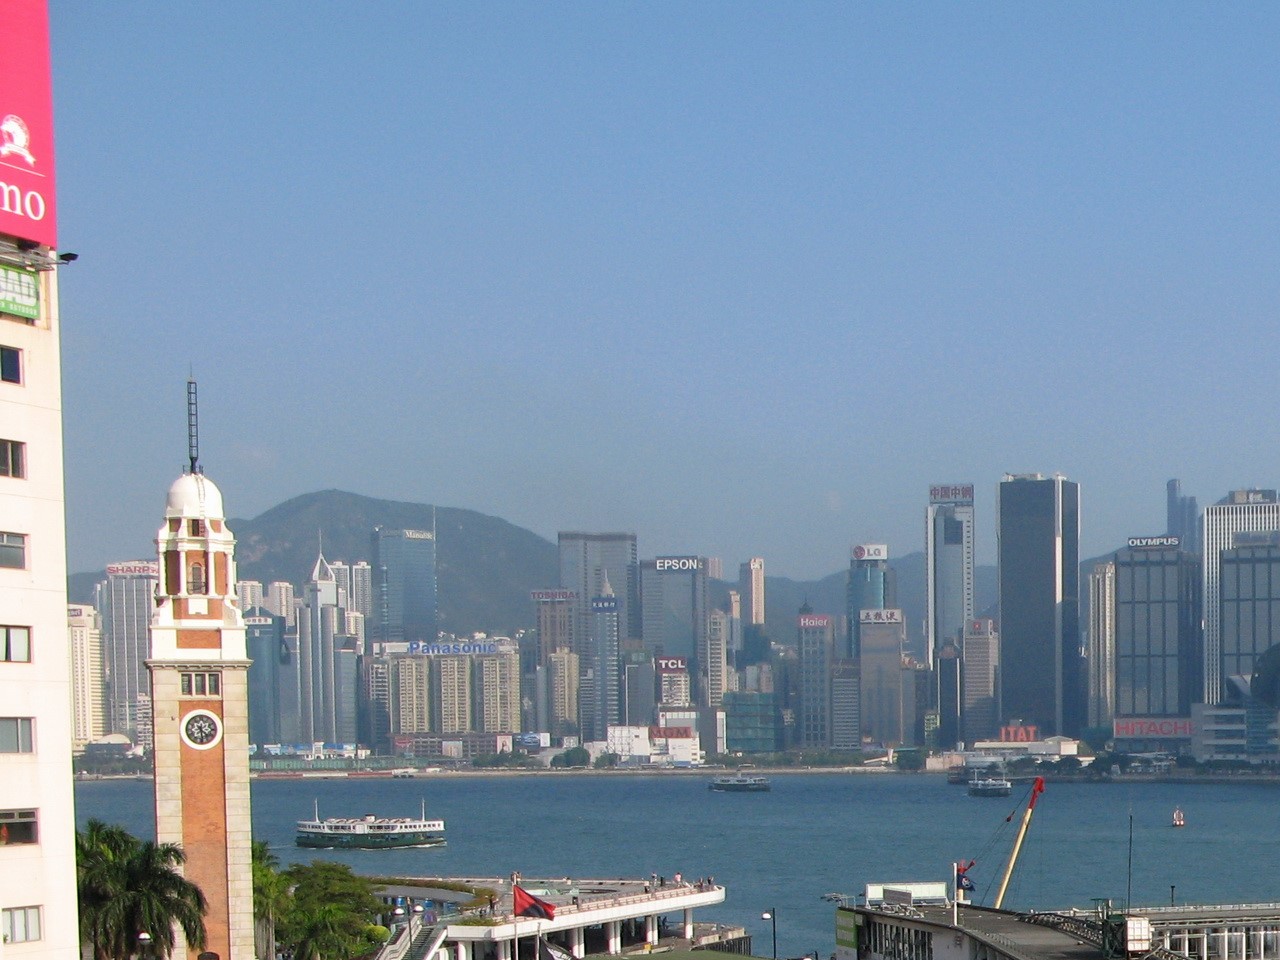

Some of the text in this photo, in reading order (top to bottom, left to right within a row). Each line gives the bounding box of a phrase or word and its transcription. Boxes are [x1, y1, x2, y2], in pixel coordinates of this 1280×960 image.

[1128, 537, 1179, 547] OLYMPUS
[866, 547, 882, 557] LG
[107, 566, 149, 574] SHARP
[656, 559, 698, 571] EPSON
[531, 591, 575, 600] TOSHIBA
[800, 617, 828, 628] Haier
[409, 641, 497, 655] Panasonic
[659, 659, 686, 669] TCL
[1001, 725, 1037, 742] ITAT
